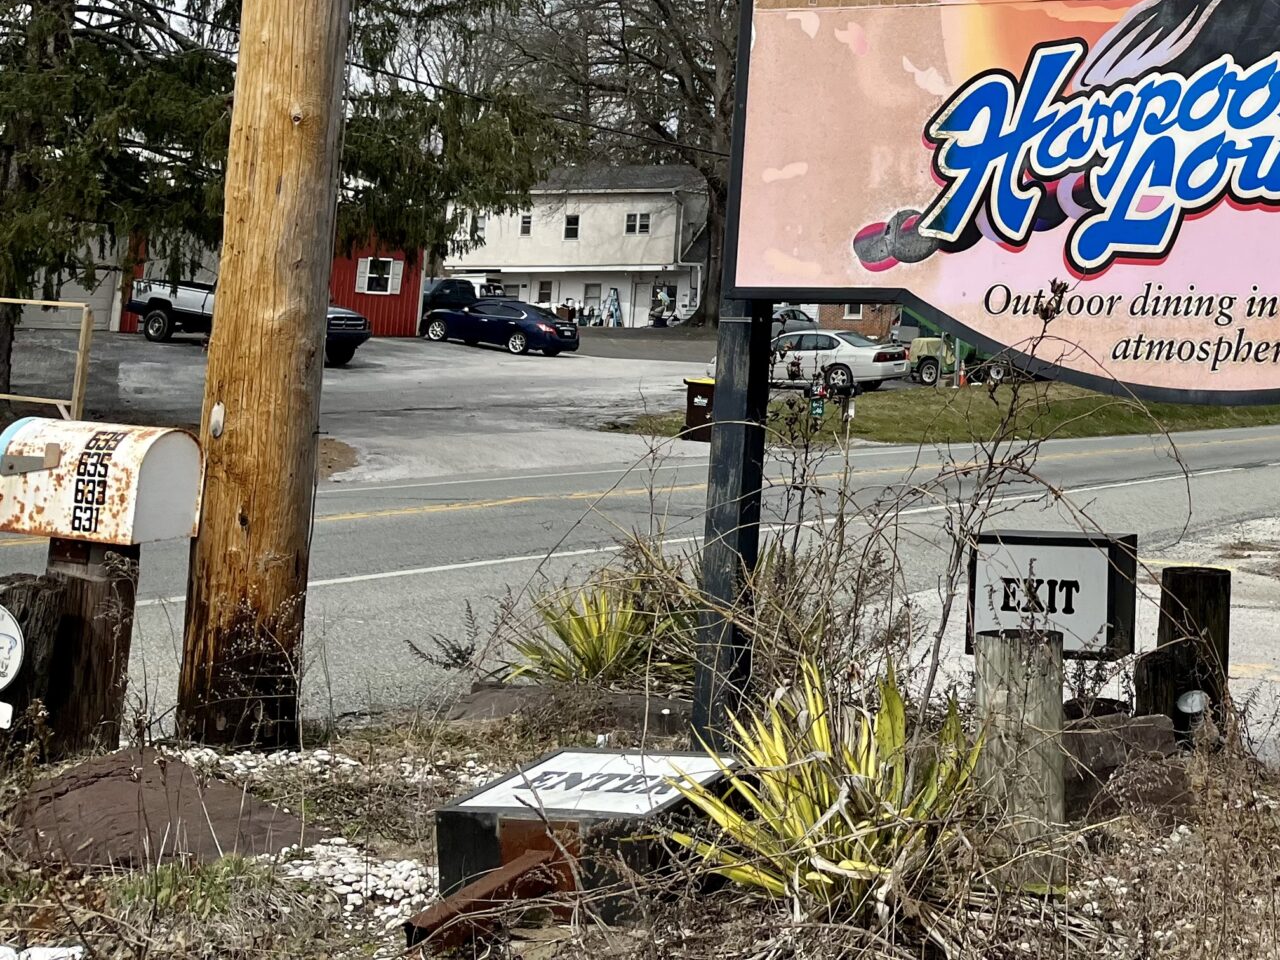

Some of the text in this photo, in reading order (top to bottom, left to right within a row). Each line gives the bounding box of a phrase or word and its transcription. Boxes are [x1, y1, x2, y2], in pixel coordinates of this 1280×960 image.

[1129, 282, 1237, 326] dining
[1246, 284, 1278, 319] in
[85, 431, 127, 451] 639
[77, 452, 112, 478] 635
[74, 478, 107, 505] 633
[72, 505, 100, 533] 631
[1000, 577, 1080, 615] EXIT
[512, 770, 684, 795] ENTER
